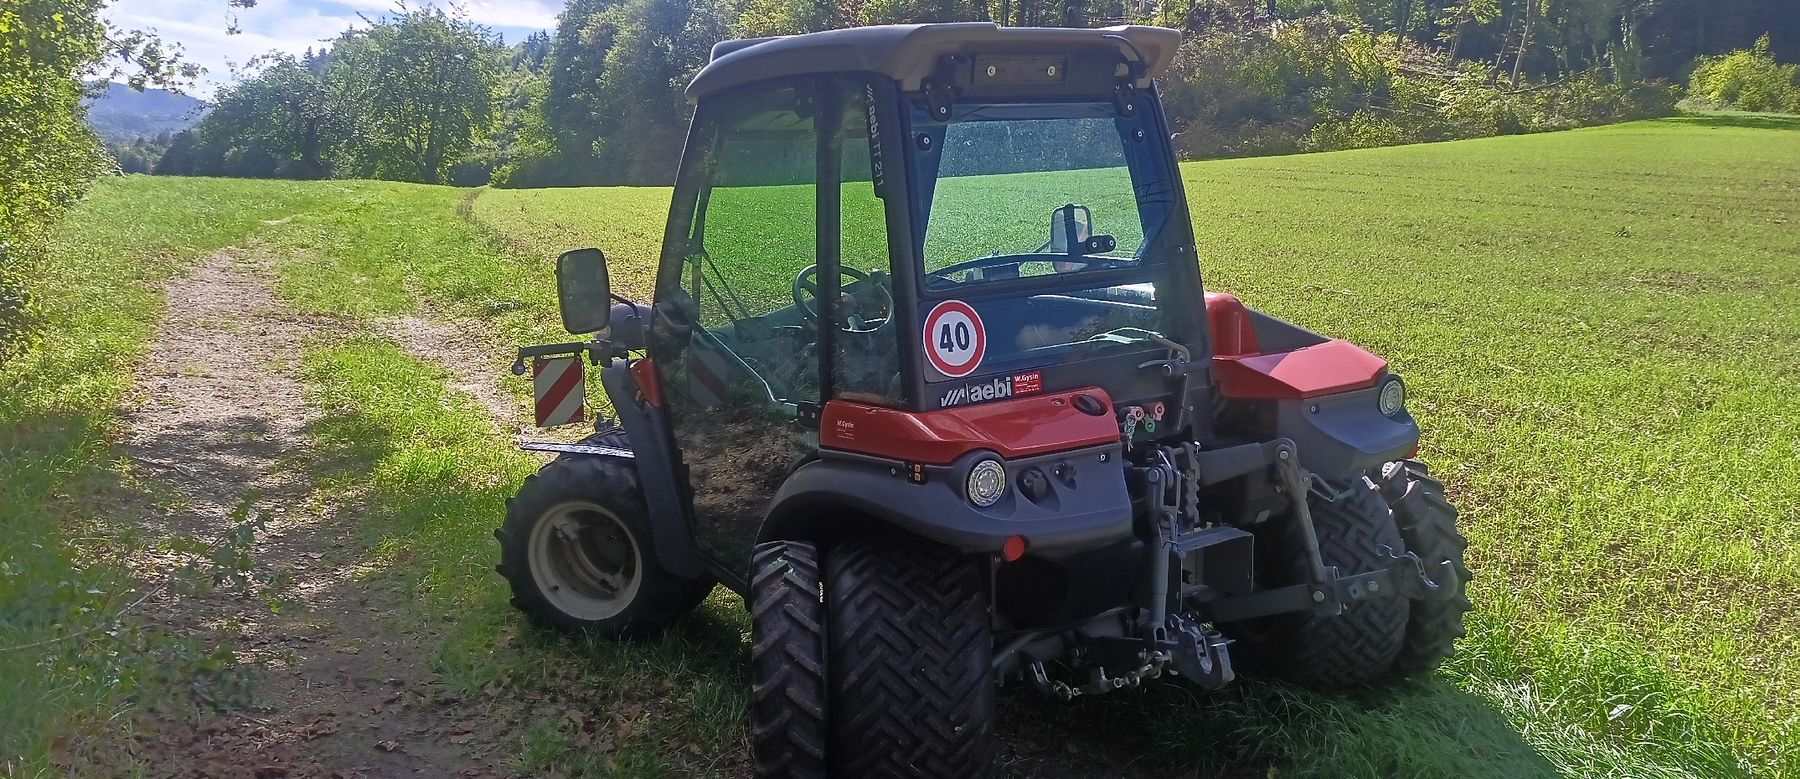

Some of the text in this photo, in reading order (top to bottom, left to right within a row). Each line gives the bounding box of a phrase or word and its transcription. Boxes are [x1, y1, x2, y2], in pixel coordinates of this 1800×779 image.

[869, 105, 884, 186] aebi TT 211
[940, 321, 970, 352] 40
[970, 376, 1012, 402] aebi
